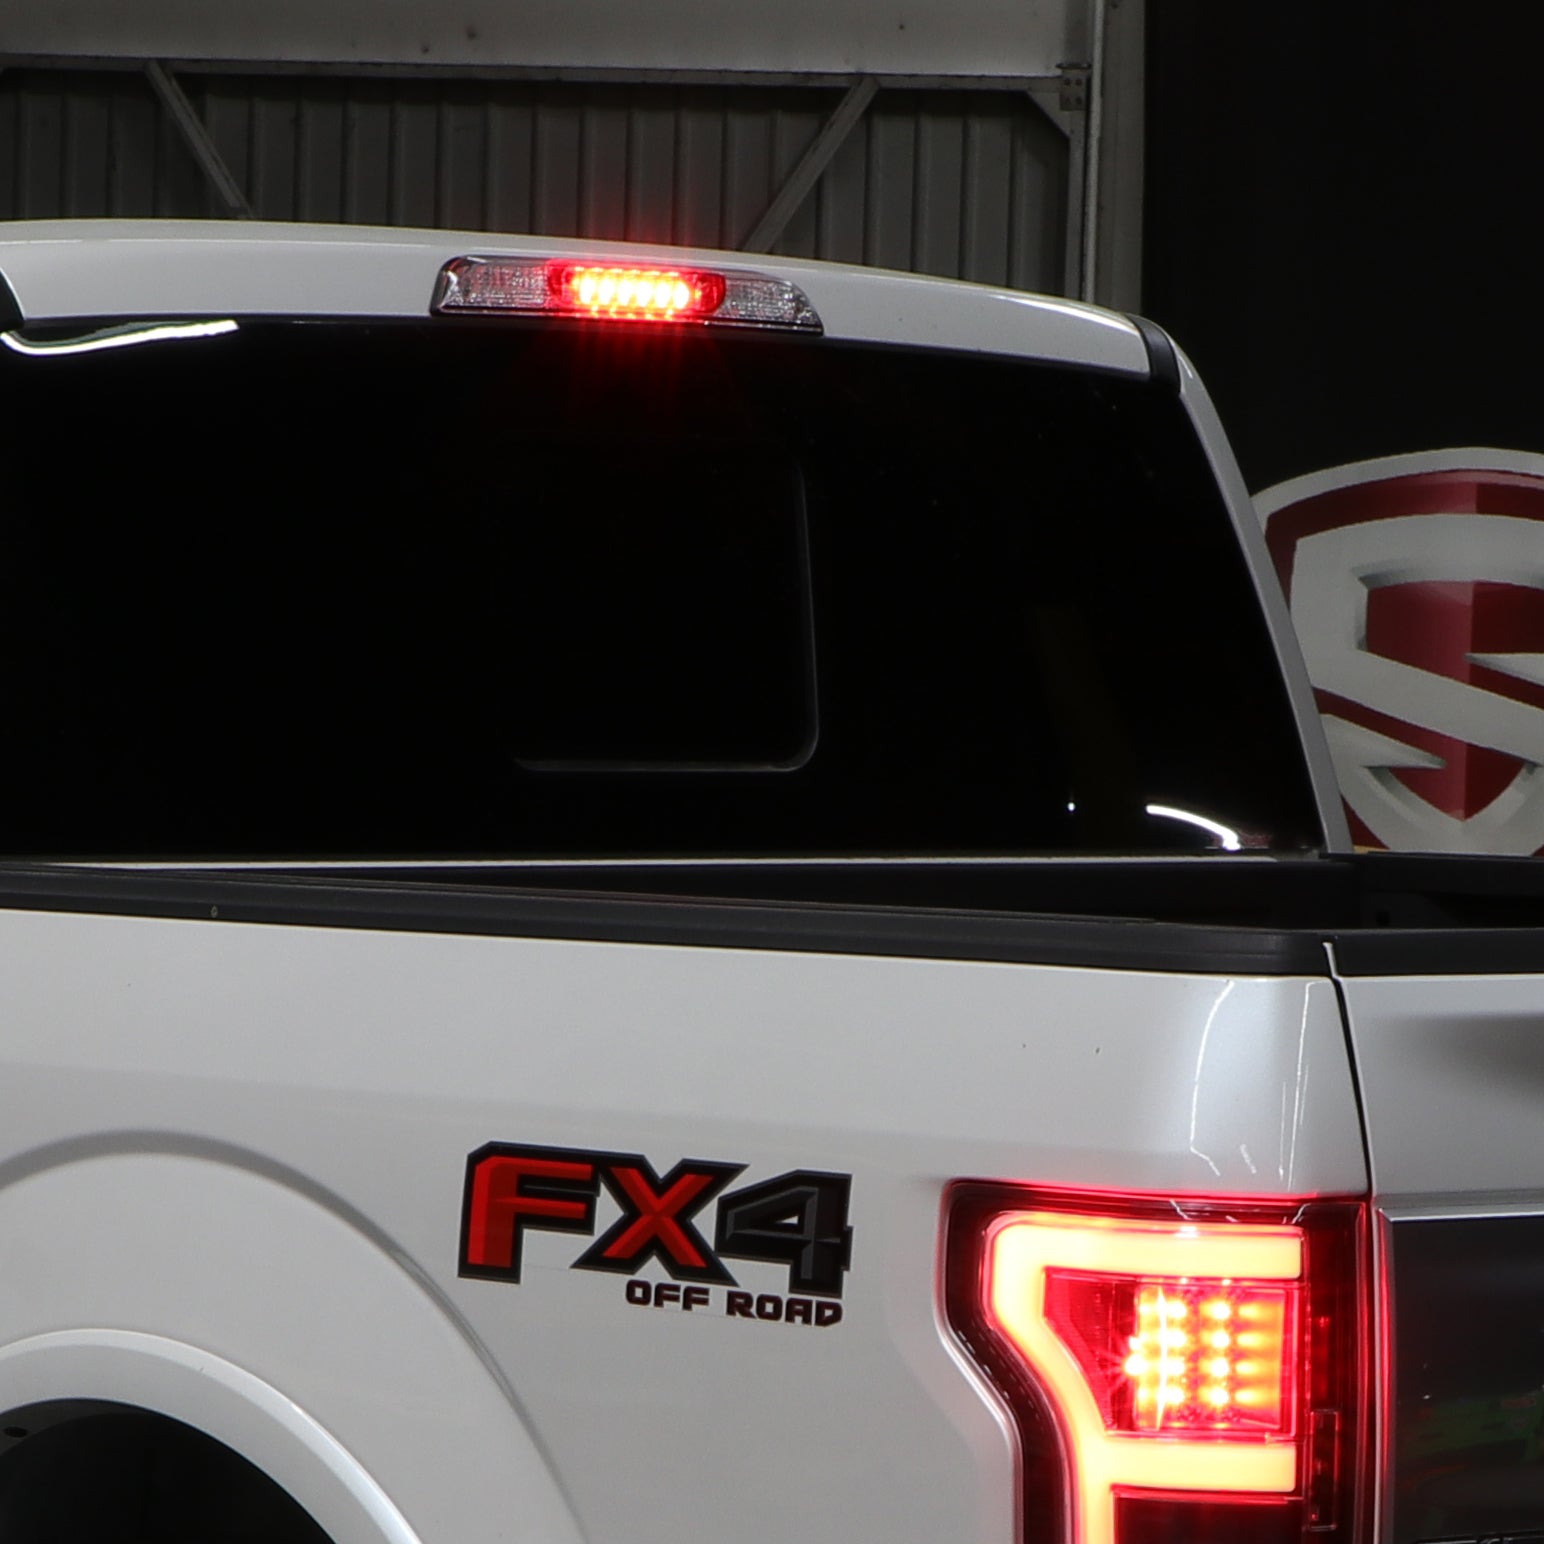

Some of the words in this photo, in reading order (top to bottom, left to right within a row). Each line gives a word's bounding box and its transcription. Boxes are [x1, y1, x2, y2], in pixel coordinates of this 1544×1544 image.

[457, 1141, 854, 1299] FX4
[625, 1279, 710, 1312] OFF
[725, 1290, 844, 1328] ROAD
